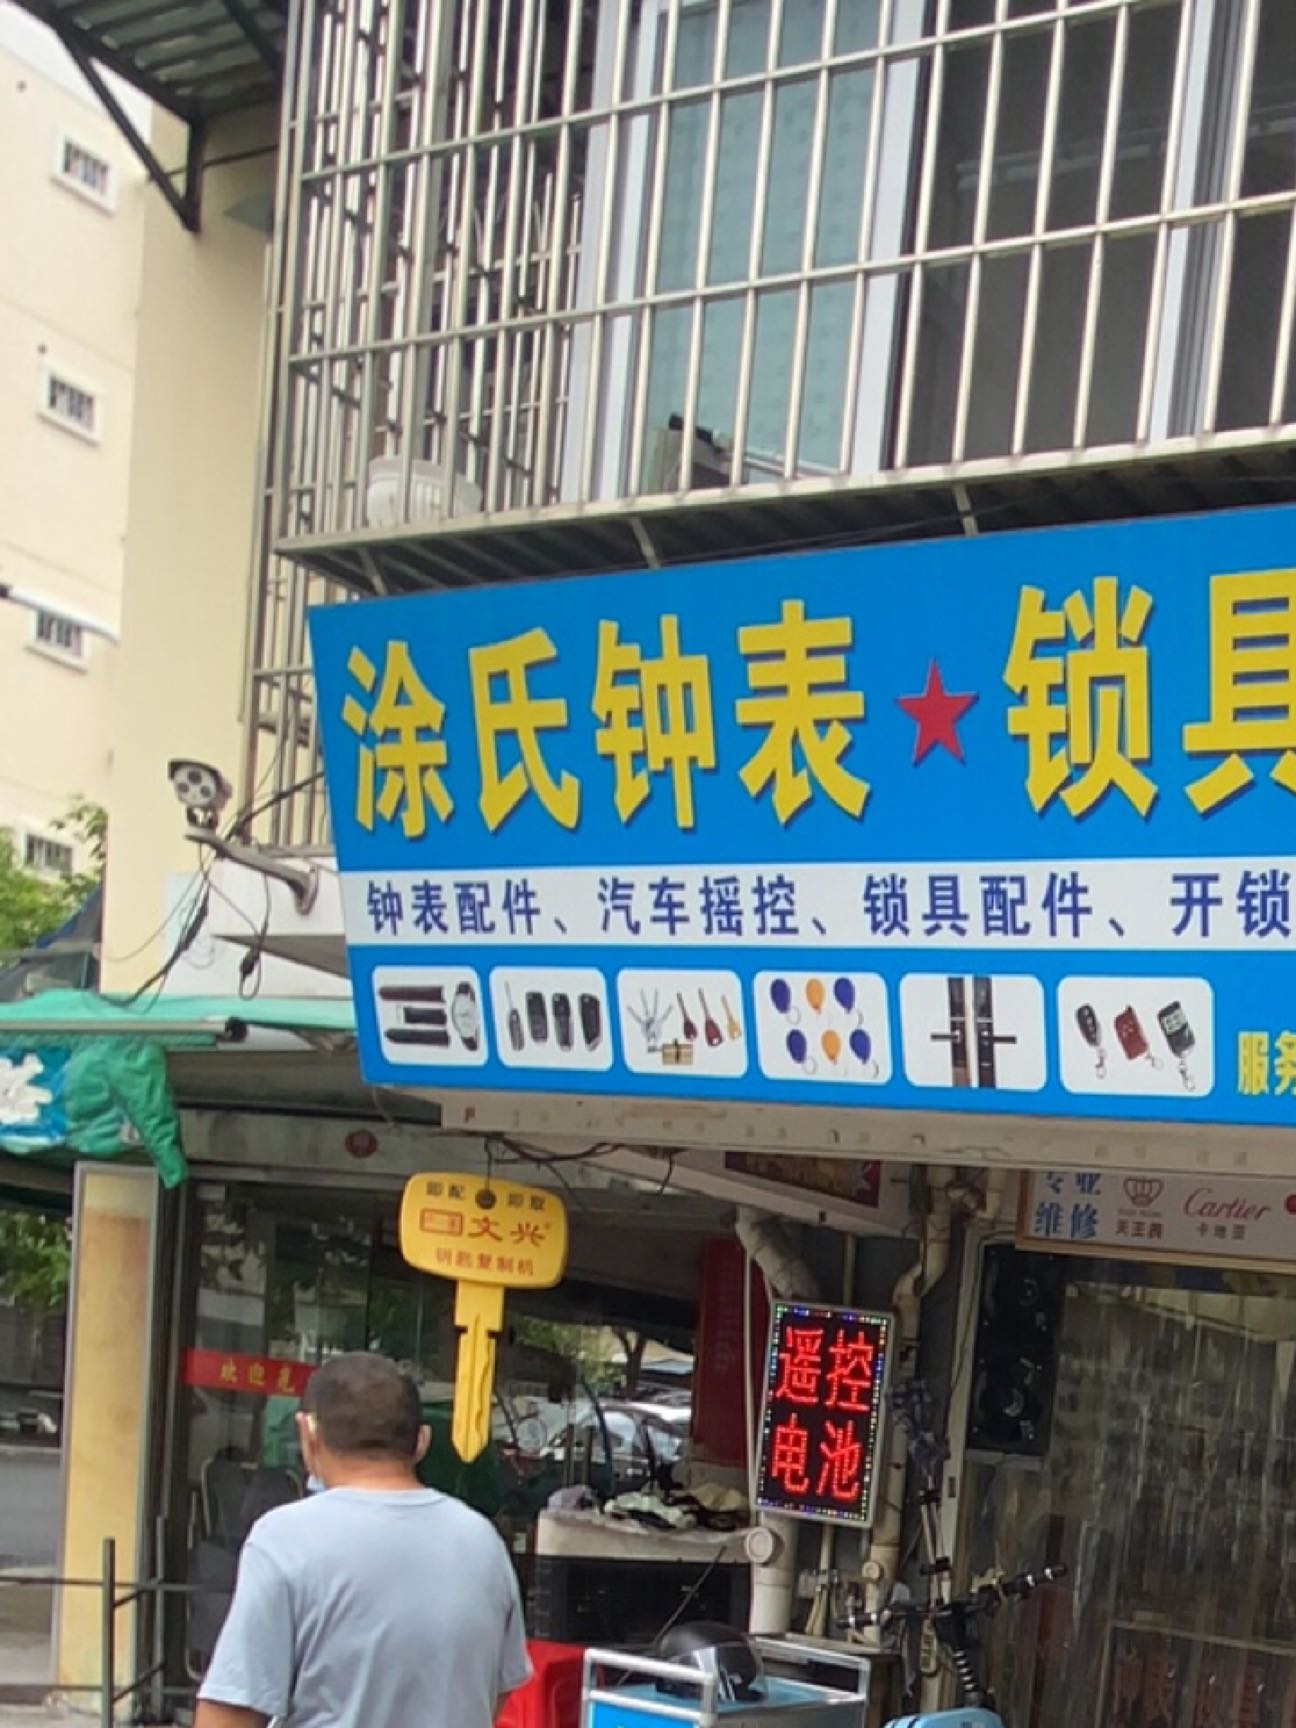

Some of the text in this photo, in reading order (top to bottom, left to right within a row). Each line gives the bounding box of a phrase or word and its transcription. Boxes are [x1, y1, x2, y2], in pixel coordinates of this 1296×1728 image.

[341, 599, 866, 838] 涂氏钟表
[1034, 1200, 1099, 1240] 维修
[1183, 1187, 1272, 1222] Cartier
[773, 1328, 875, 1413] 遥控
[769, 1416, 864, 1499] 电池
